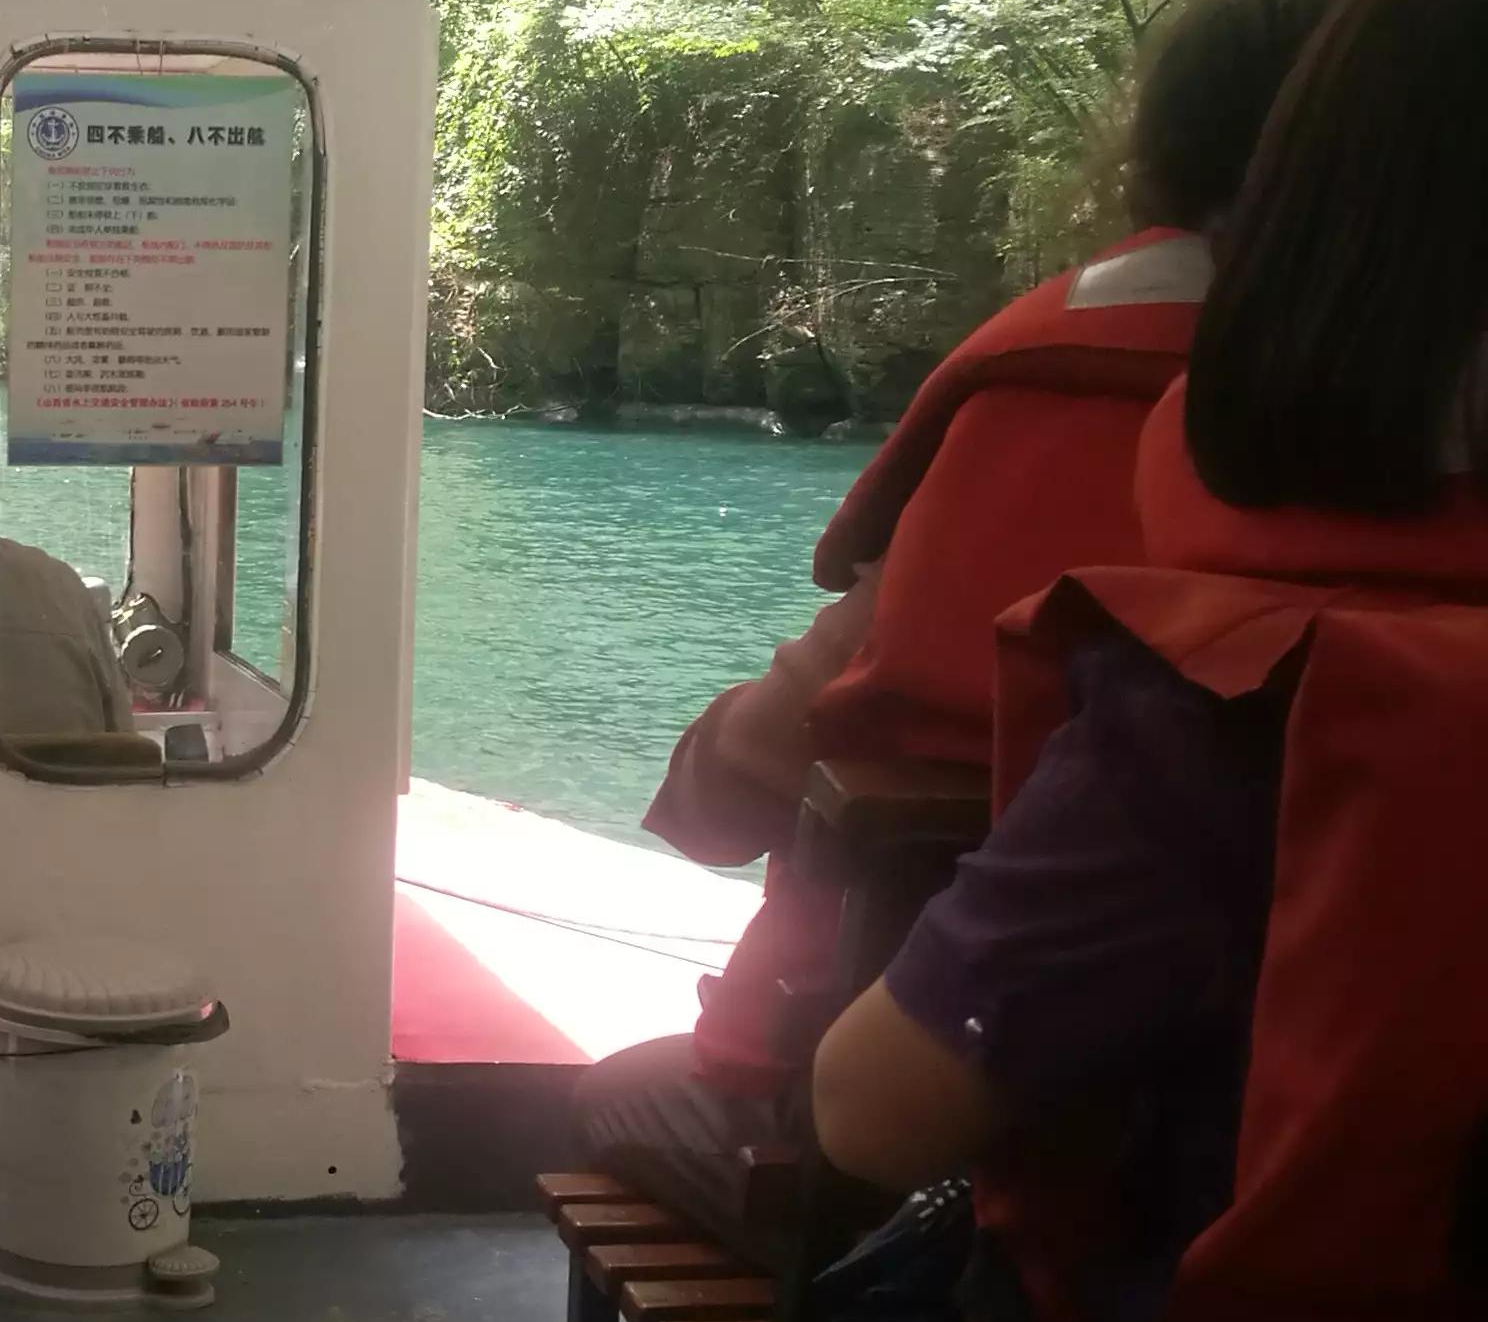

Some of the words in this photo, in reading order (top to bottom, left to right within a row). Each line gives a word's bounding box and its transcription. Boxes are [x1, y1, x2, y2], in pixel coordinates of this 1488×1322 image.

[86, 124, 266, 147] 四不乘船、八不出航
